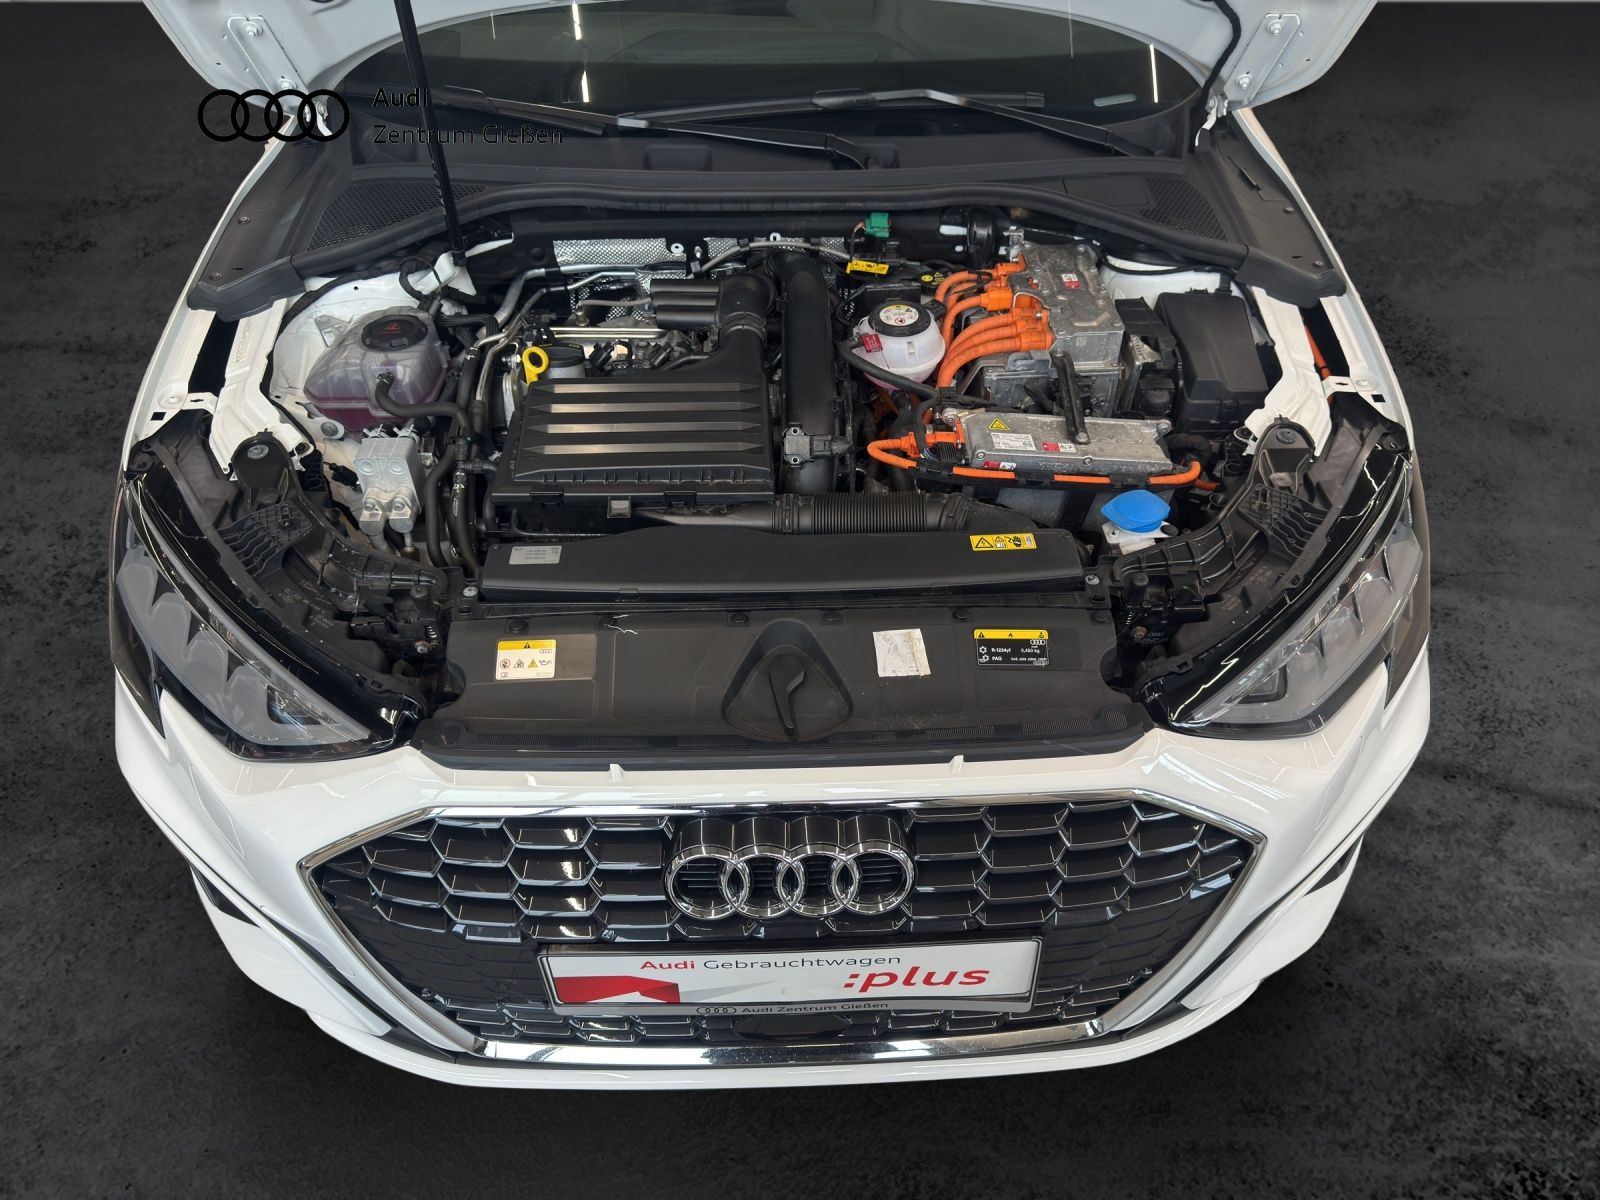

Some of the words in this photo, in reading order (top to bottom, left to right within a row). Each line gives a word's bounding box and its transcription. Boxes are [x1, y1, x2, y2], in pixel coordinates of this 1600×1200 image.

[639, 960, 696, 970] Audi
[703, 955, 901, 970] Gebrauchtwagen
[777, 1005, 837, 1013] Zentrum
[840, 1003, 889, 1011] Gießen
